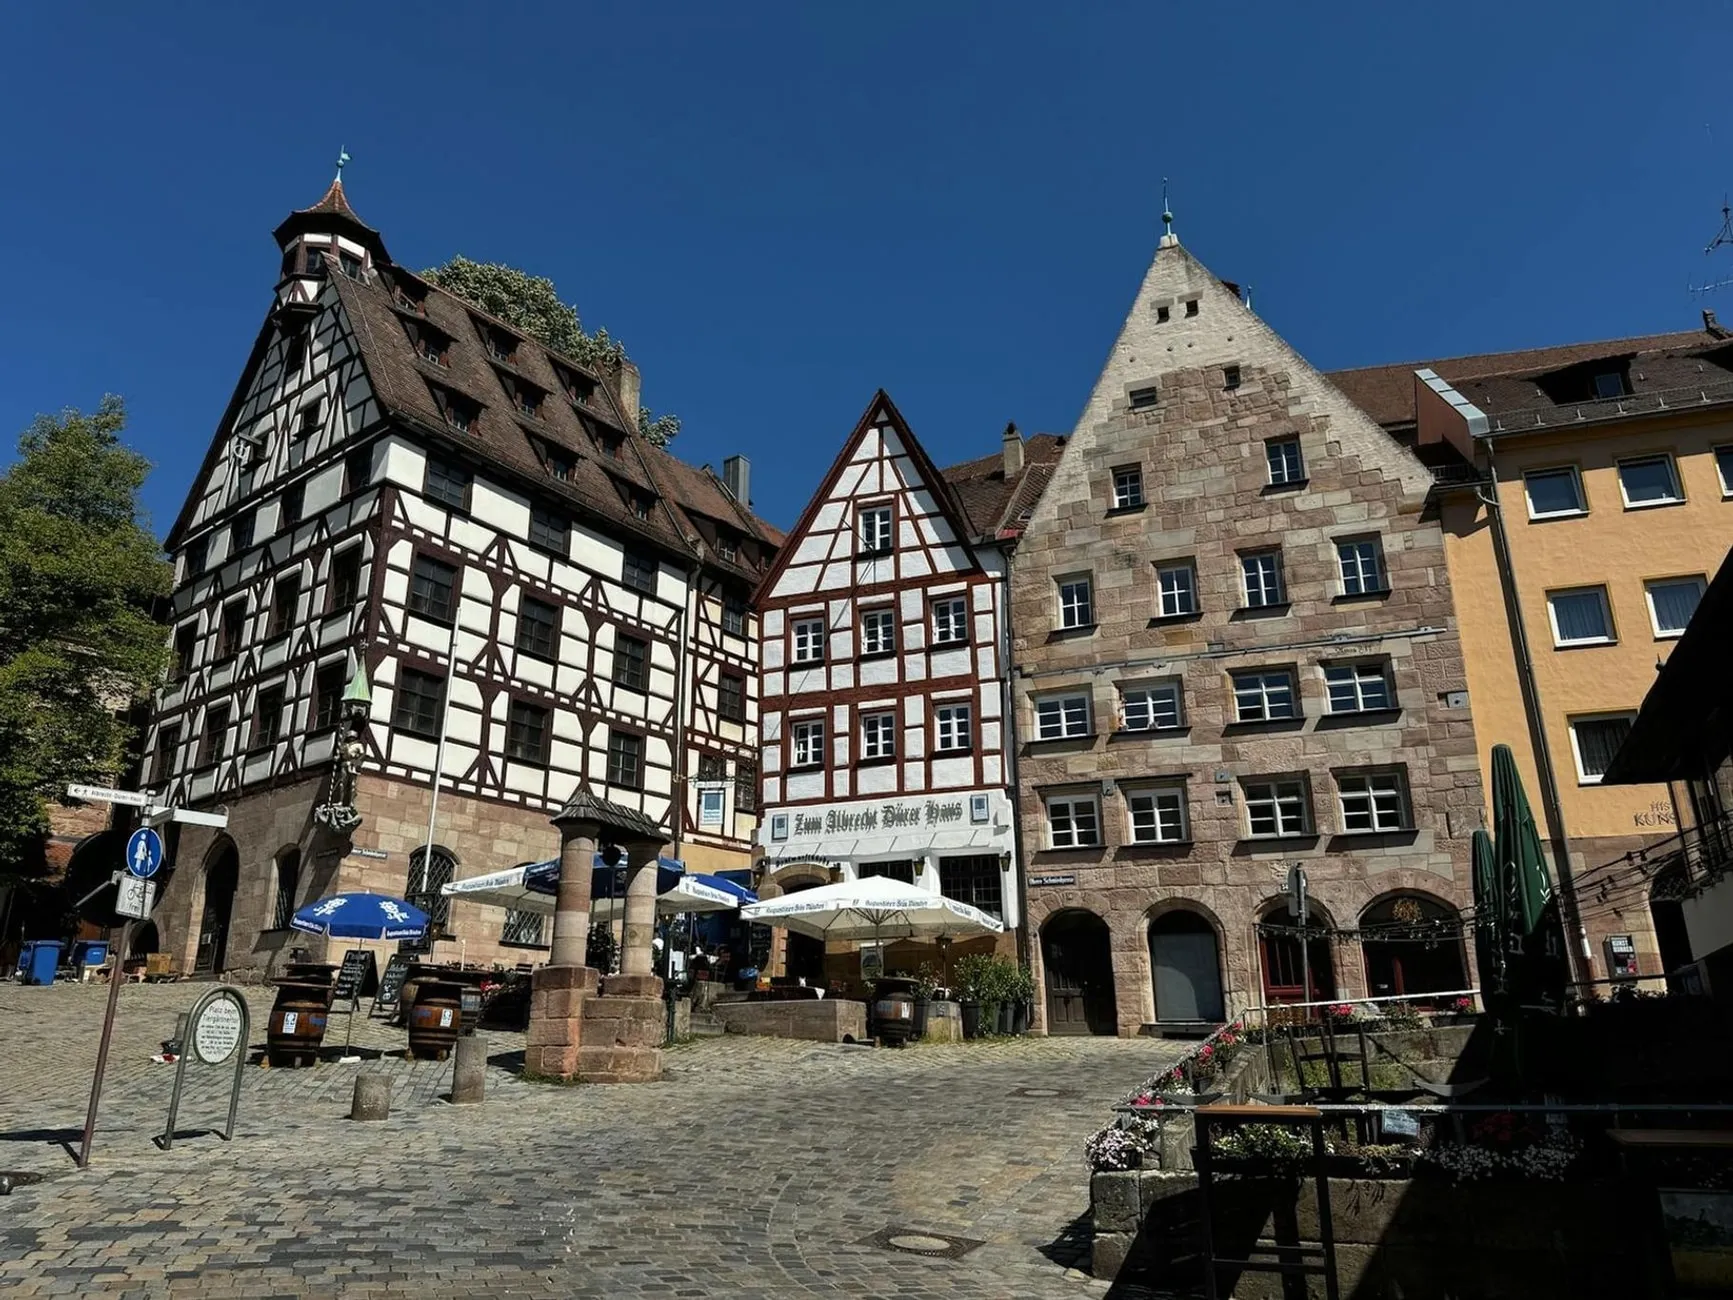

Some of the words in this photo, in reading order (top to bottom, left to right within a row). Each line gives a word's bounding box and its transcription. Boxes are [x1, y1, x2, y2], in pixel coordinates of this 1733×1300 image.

[794, 813, 822, 836] Zum
[825, 808, 878, 834] Albrecht
[881, 801, 921, 830] Dürer
[924, 799, 963, 831] Haus
